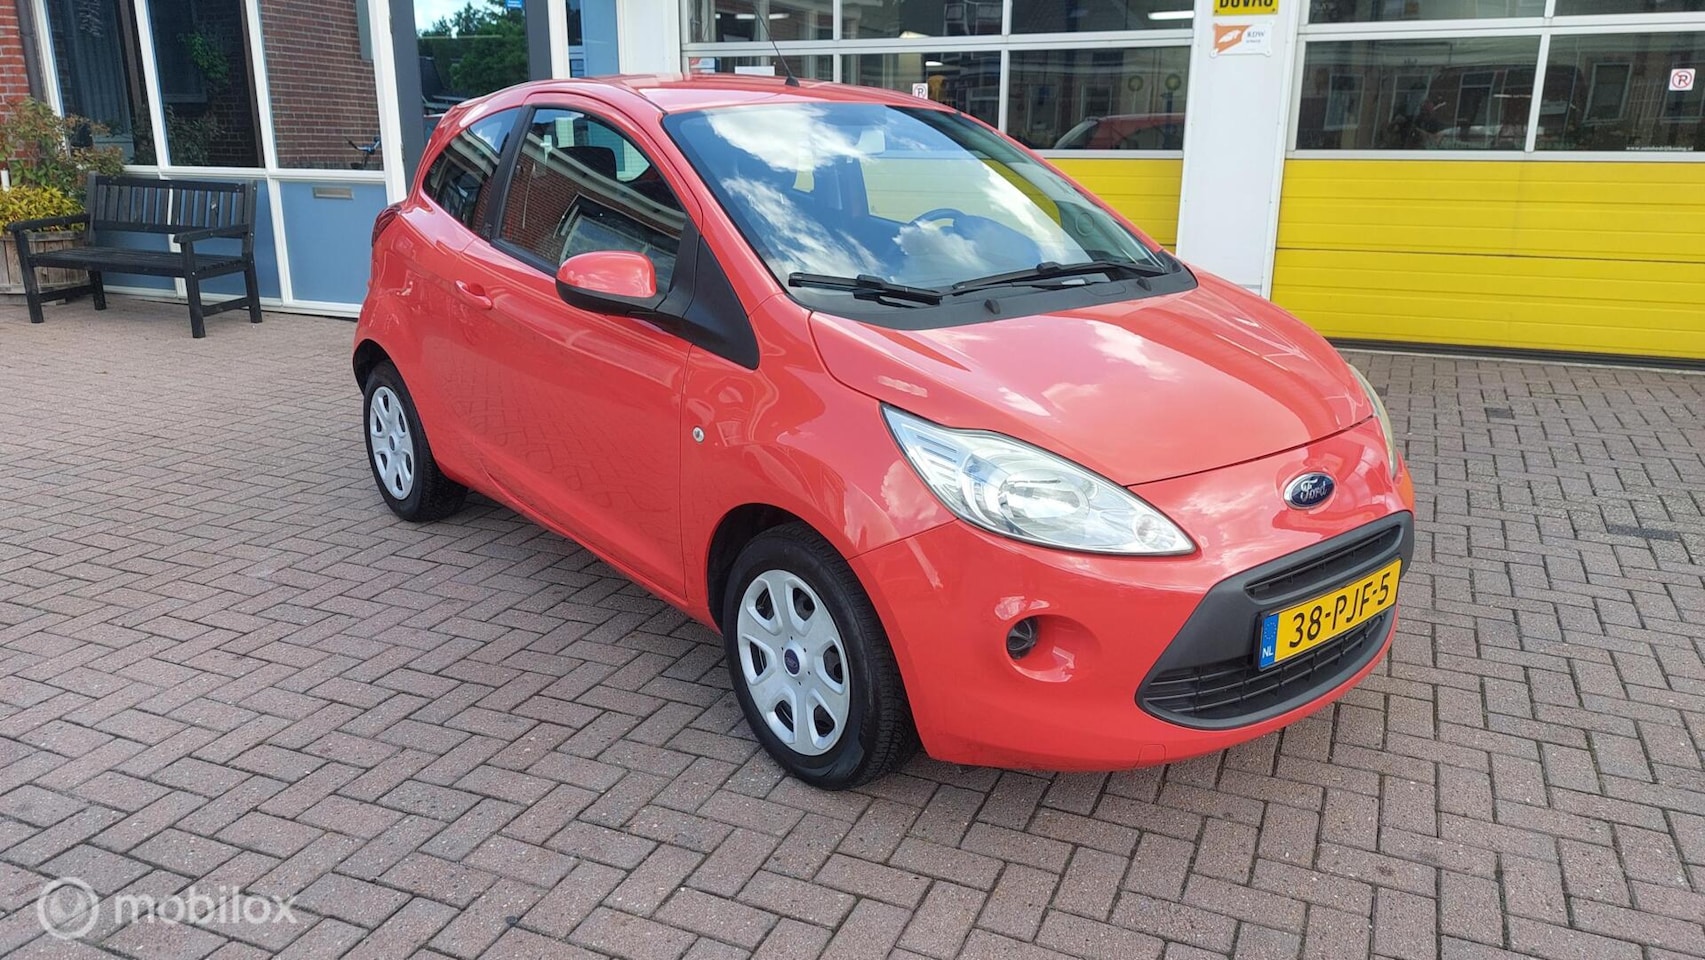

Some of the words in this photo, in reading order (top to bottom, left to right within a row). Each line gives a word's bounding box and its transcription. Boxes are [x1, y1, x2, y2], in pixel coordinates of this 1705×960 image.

[1300, 478, 1328, 502] Ford
[1289, 572, 1391, 648] 38-PJF-5
[1262, 645, 1274, 659] NL
